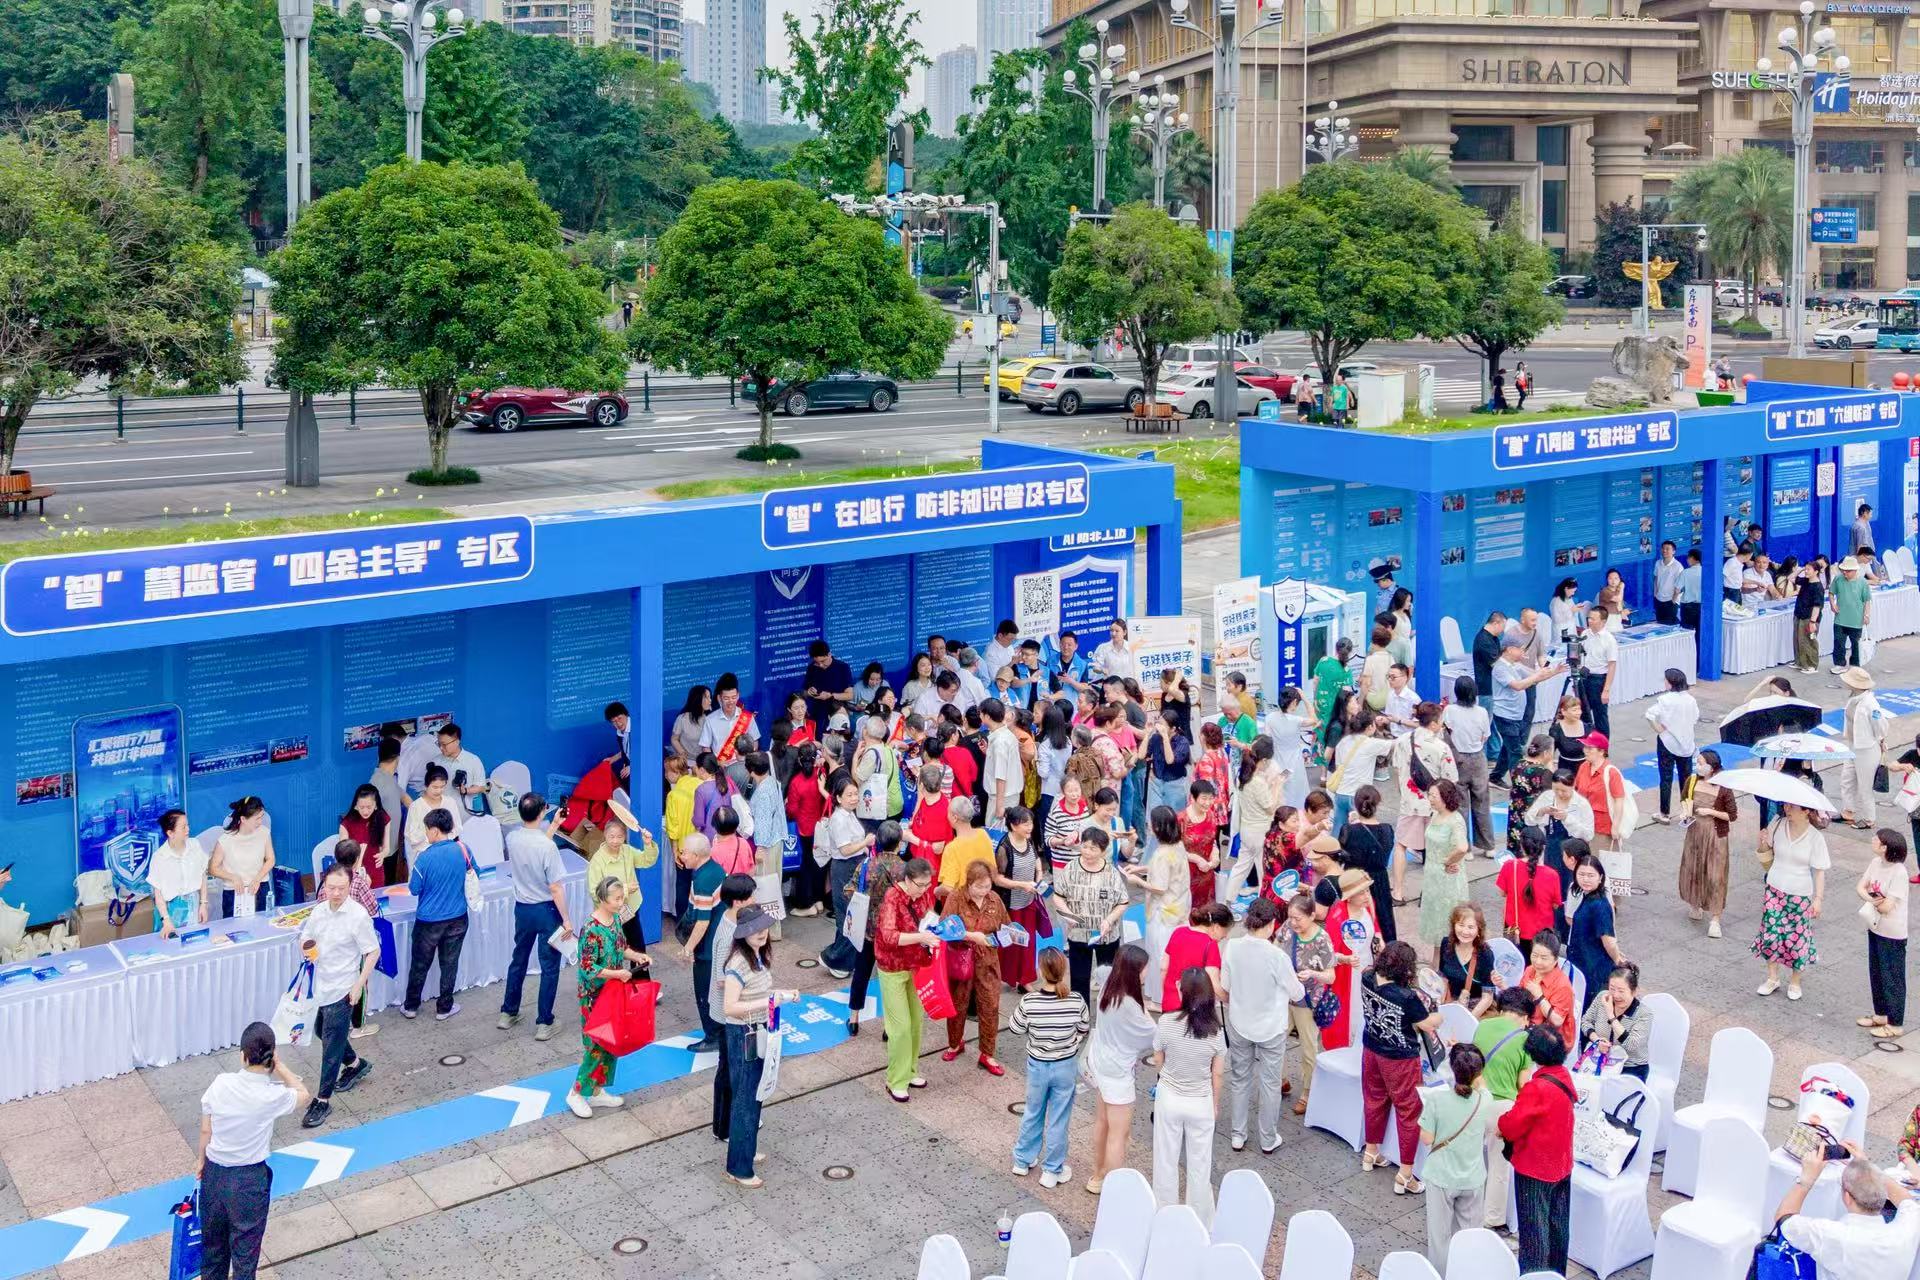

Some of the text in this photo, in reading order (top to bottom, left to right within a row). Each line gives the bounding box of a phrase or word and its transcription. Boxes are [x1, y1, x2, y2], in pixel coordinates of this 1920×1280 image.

[1827, 4, 1911, 14] BY WYNDHAM
[1462, 58, 1631, 86] SHERATON
[1880, 74, 1920, 88] 智选假
[1856, 90, 1908, 108] Holiday
[1885, 112, 1920, 123] 洲际酒
[890, 132, 899, 151] A
[1879, 401, 1897, 419] 专区
[1647, 421, 1671, 442] 专区
[774, 477, 1086, 533] “智” 在必行 防非知识普及专区
[43, 569, 123, 610] “智”
[144, 559, 257, 602] 慧监管
[457, 531, 520, 569] 专区
[1140, 651, 1192, 667] 守好钱袋子
[1284, 628, 1296, 687] 防非工
[1142, 665, 1193, 682] 护好家
